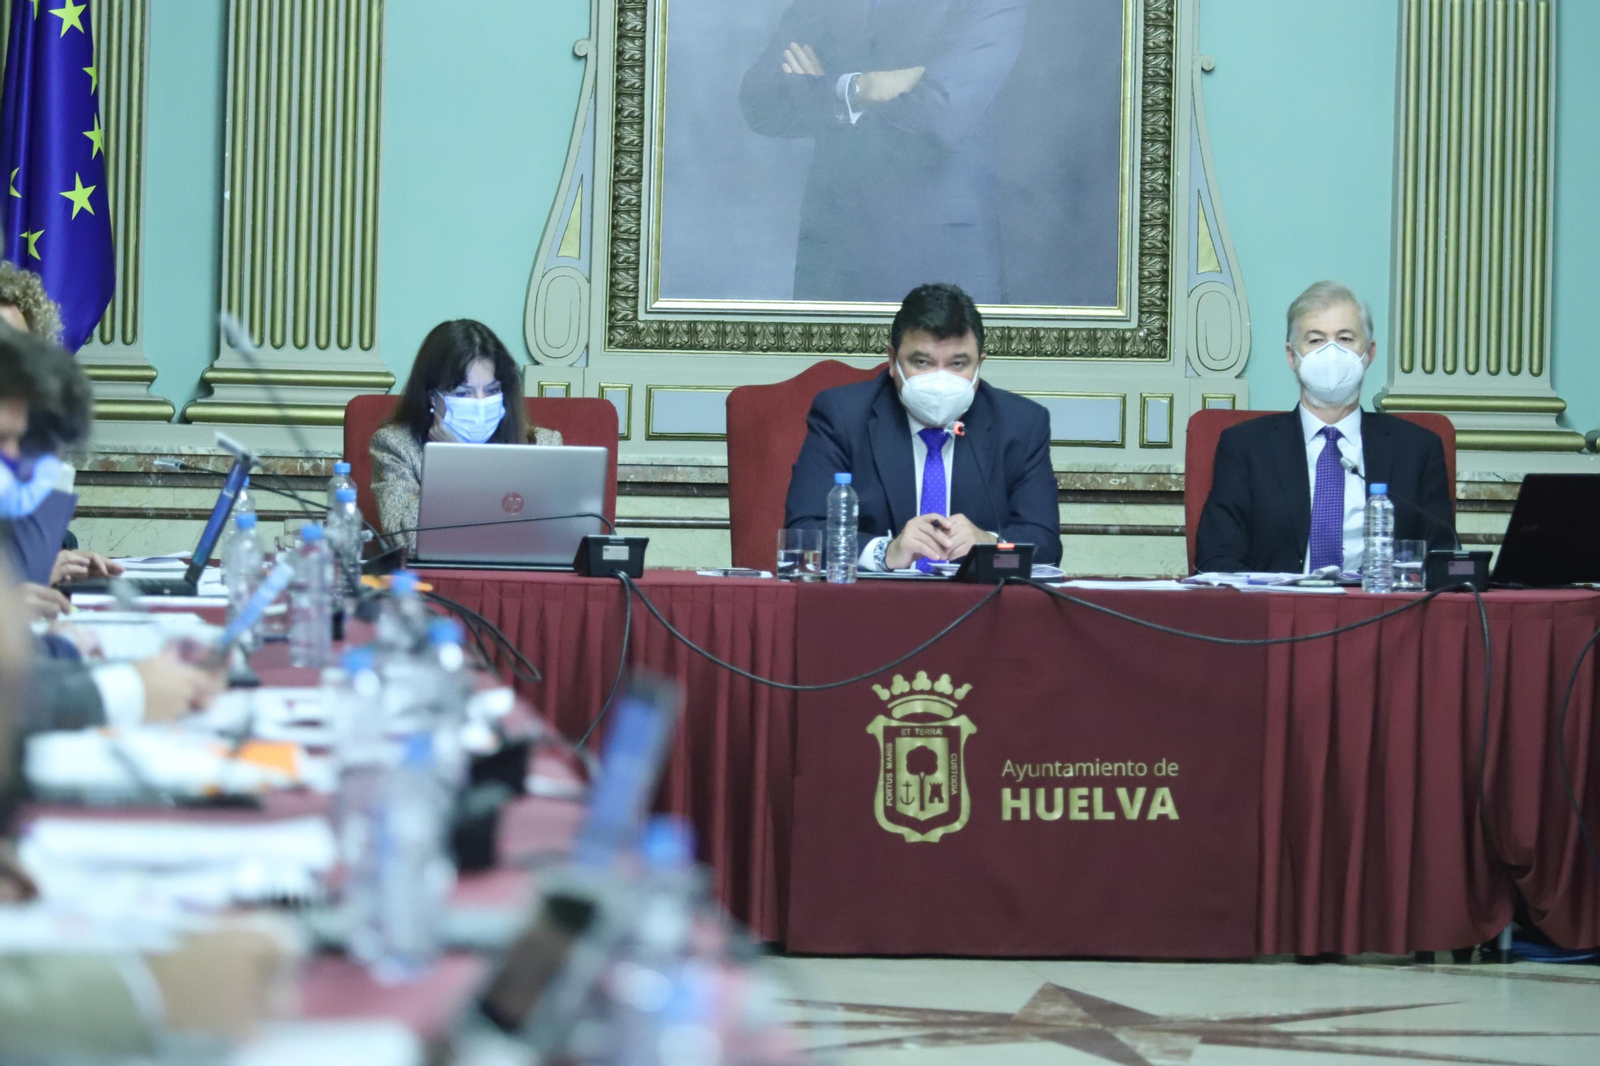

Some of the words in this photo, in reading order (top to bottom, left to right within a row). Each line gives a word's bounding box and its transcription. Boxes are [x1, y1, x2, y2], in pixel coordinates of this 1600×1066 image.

[901, 728, 911, 736] ET
[950, 753, 958, 795] CUSTODIA
[1001, 758, 1147, 782] Ayuntamiento
[1153, 758, 1179, 777] de
[1001, 787, 1180, 821] HUELVA
